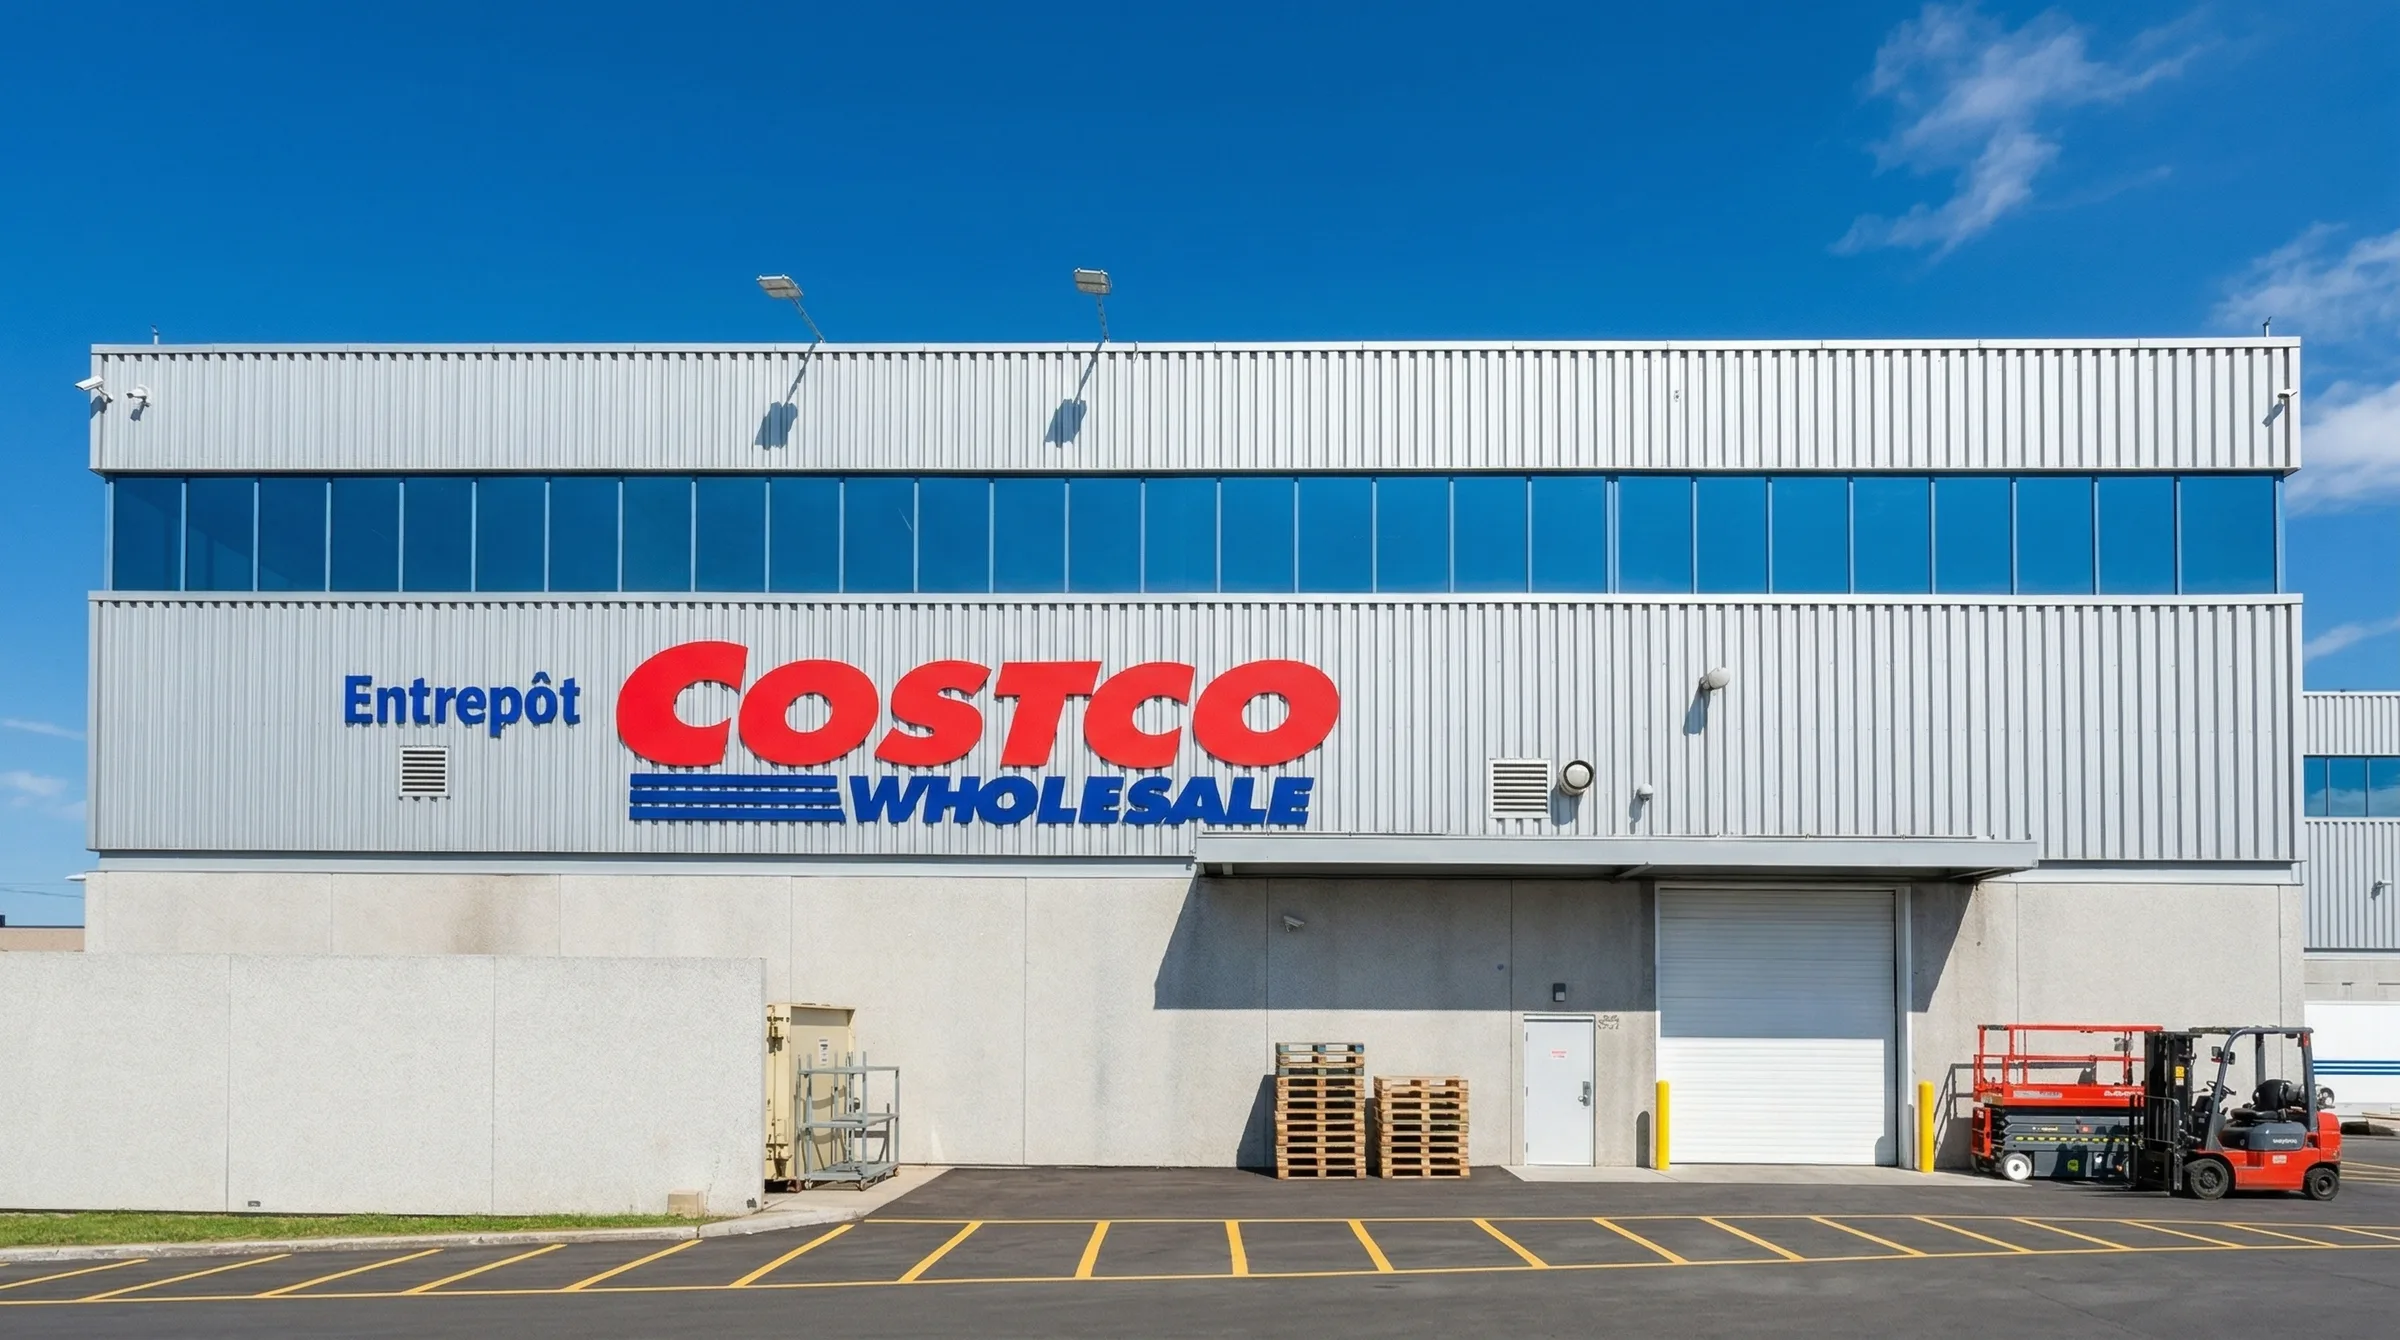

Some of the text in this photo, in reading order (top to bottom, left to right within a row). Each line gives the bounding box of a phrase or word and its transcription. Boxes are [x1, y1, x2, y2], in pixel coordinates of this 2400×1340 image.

[344, 671, 581, 737] Entrepôt
[617, 641, 1340, 768] COSTCO
[850, 776, 1314, 825] WHOLESALE
